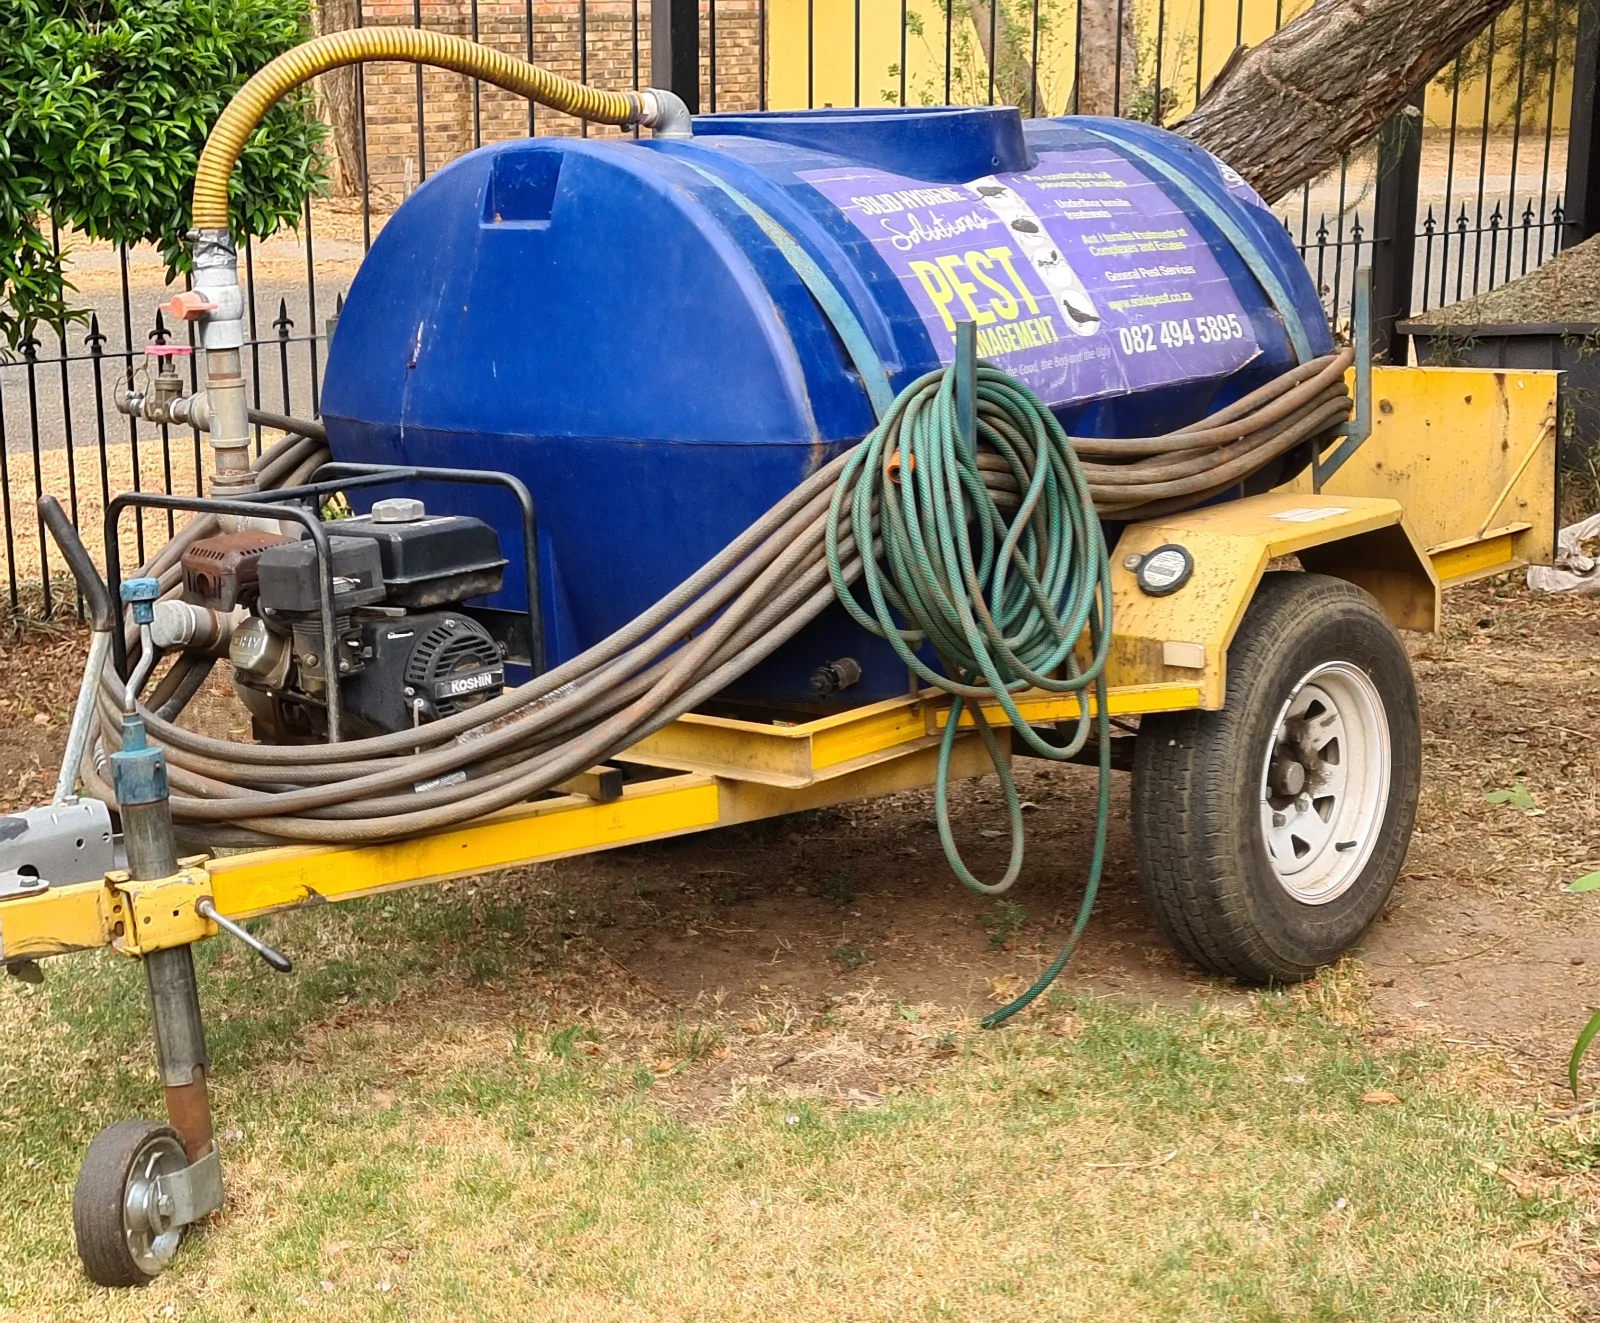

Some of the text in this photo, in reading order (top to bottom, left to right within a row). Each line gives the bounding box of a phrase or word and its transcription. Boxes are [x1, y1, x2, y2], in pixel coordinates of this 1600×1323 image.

[850, 187, 968, 216] SOLID HYGIENE
[880, 209, 989, 251] Solutions
[1102, 231, 1136, 242] termite
[1132, 229, 1178, 240] treatments
[1176, 228, 1189, 237] at
[1089, 241, 1187, 257] Complexes and Estates
[1104, 265, 1197, 281] General Pest Services
[908, 246, 1040, 332] PEST
[1120, 313, 1243, 355] 082 494 5895
[451, 674, 492, 693] KOSHIN
